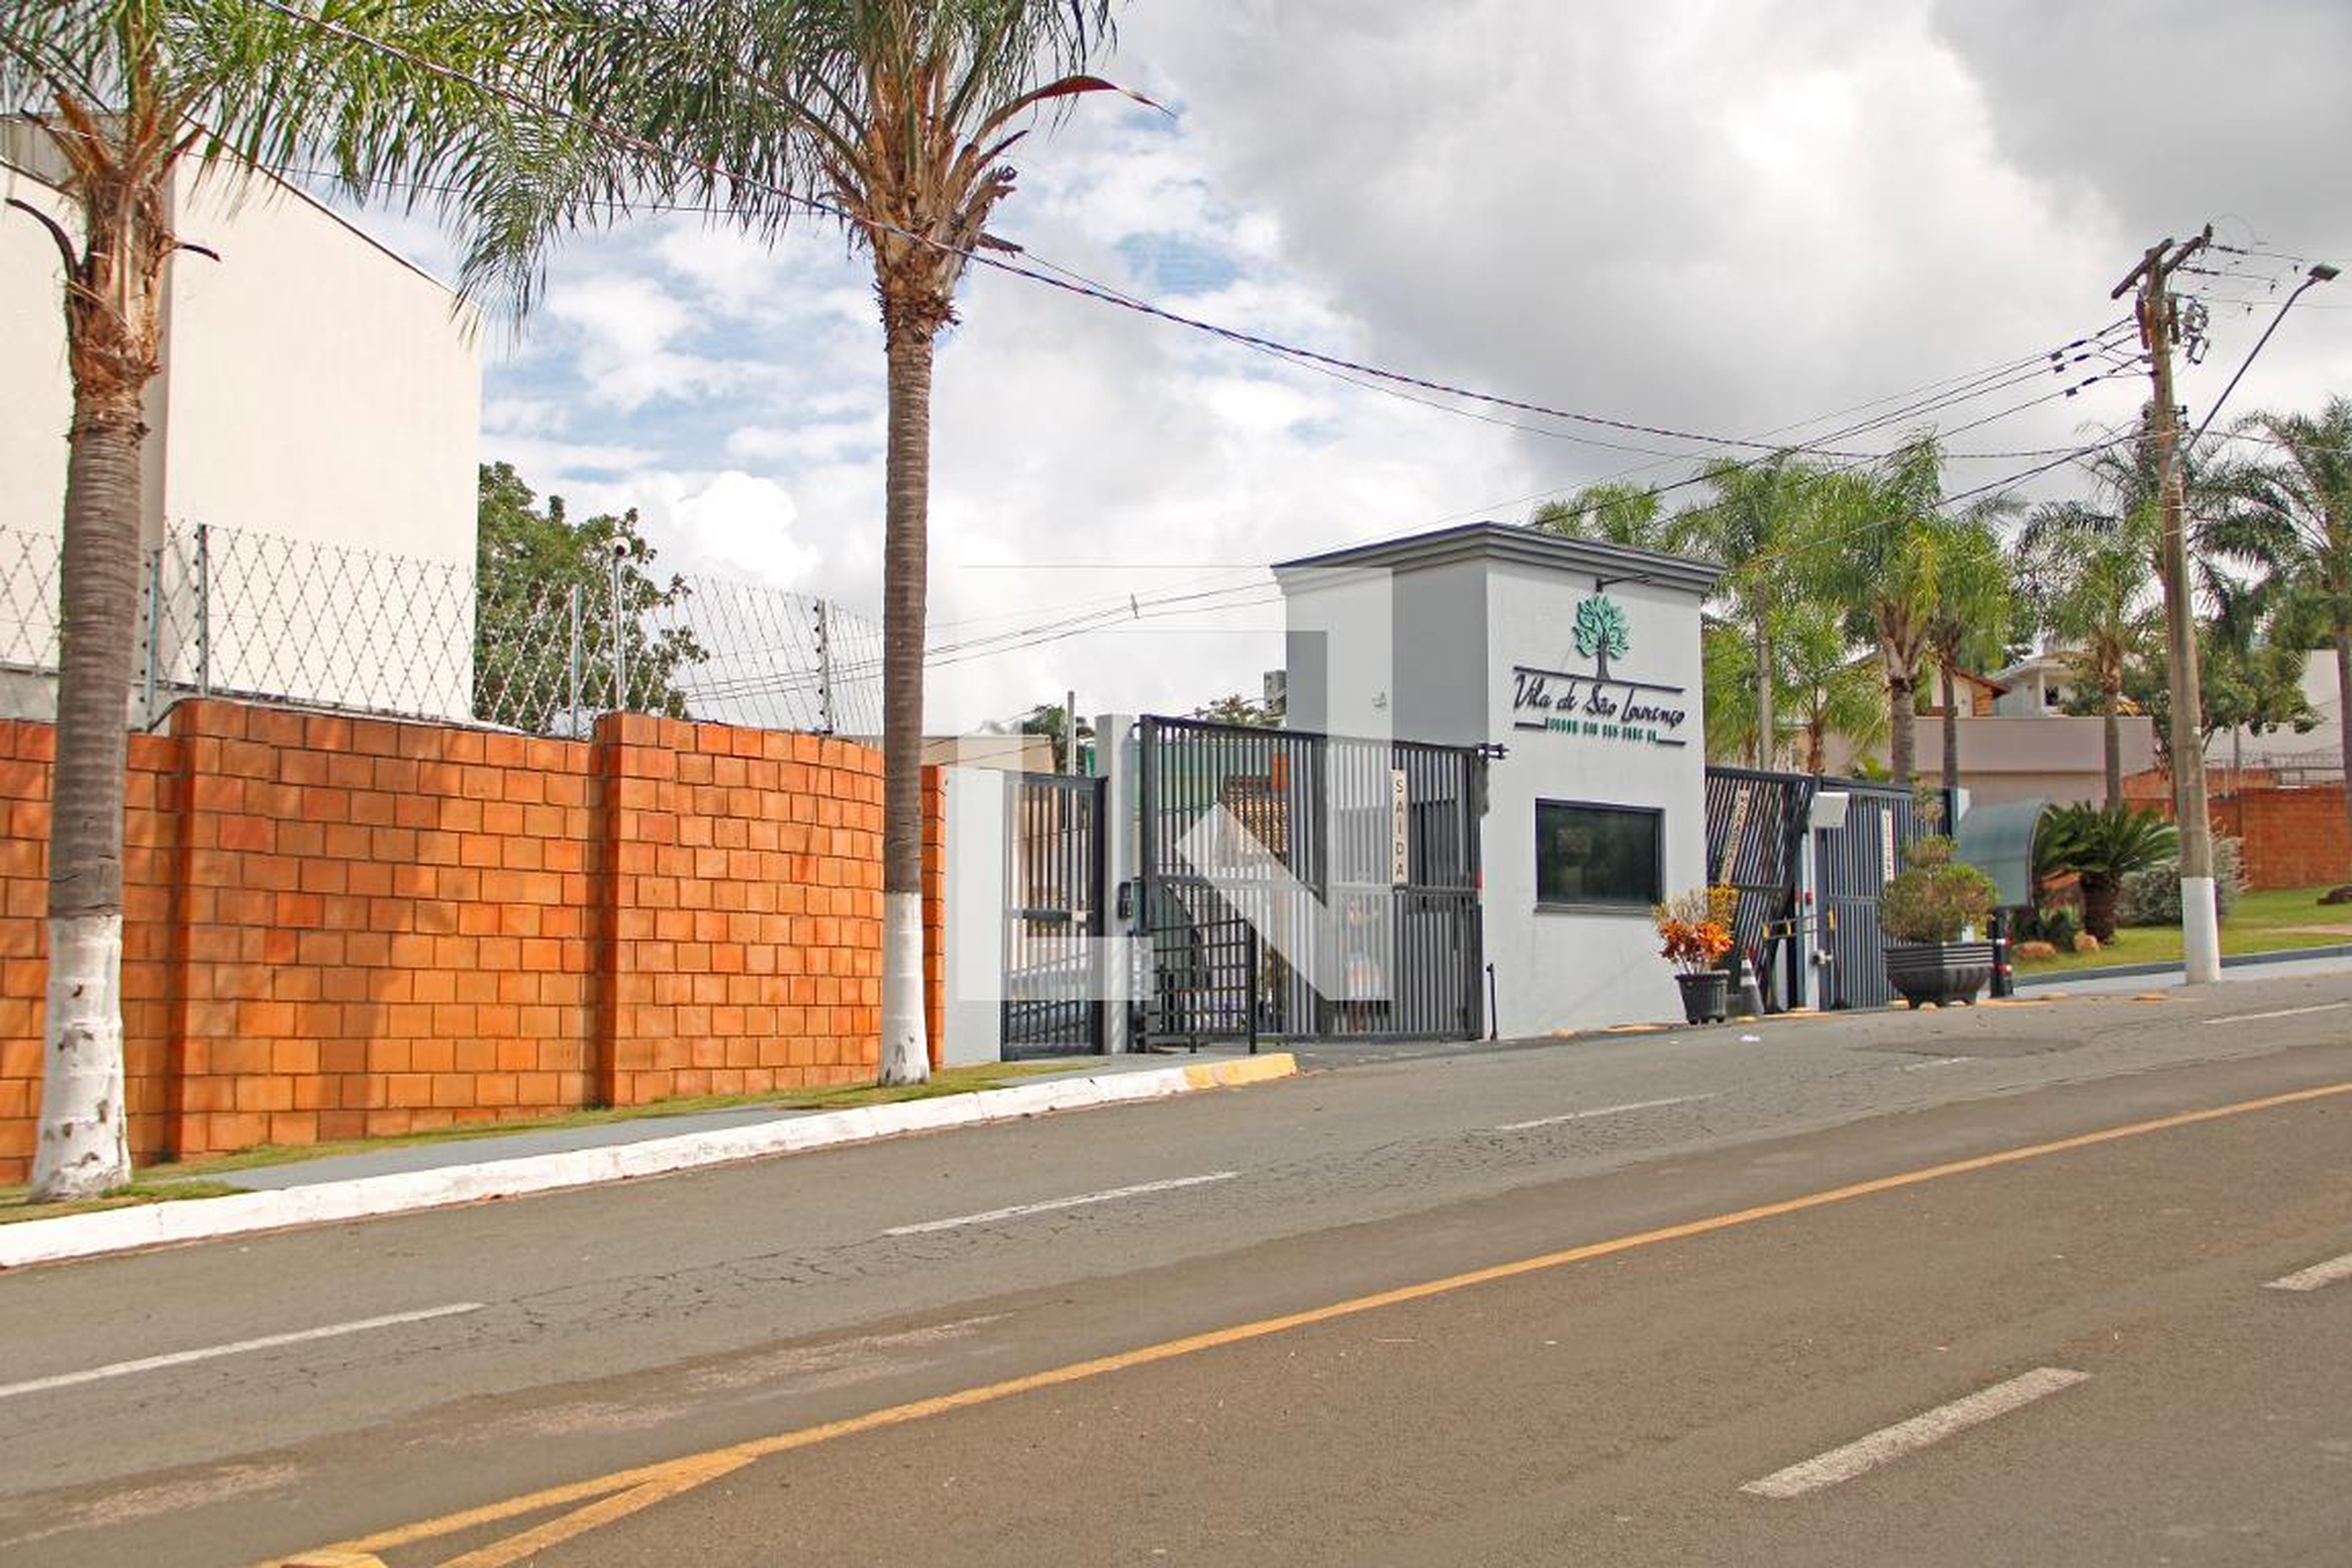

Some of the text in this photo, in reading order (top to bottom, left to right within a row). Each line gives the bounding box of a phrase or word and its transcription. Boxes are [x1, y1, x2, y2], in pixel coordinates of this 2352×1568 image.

[1515, 673, 1686, 729] Vila de São Lourenço
